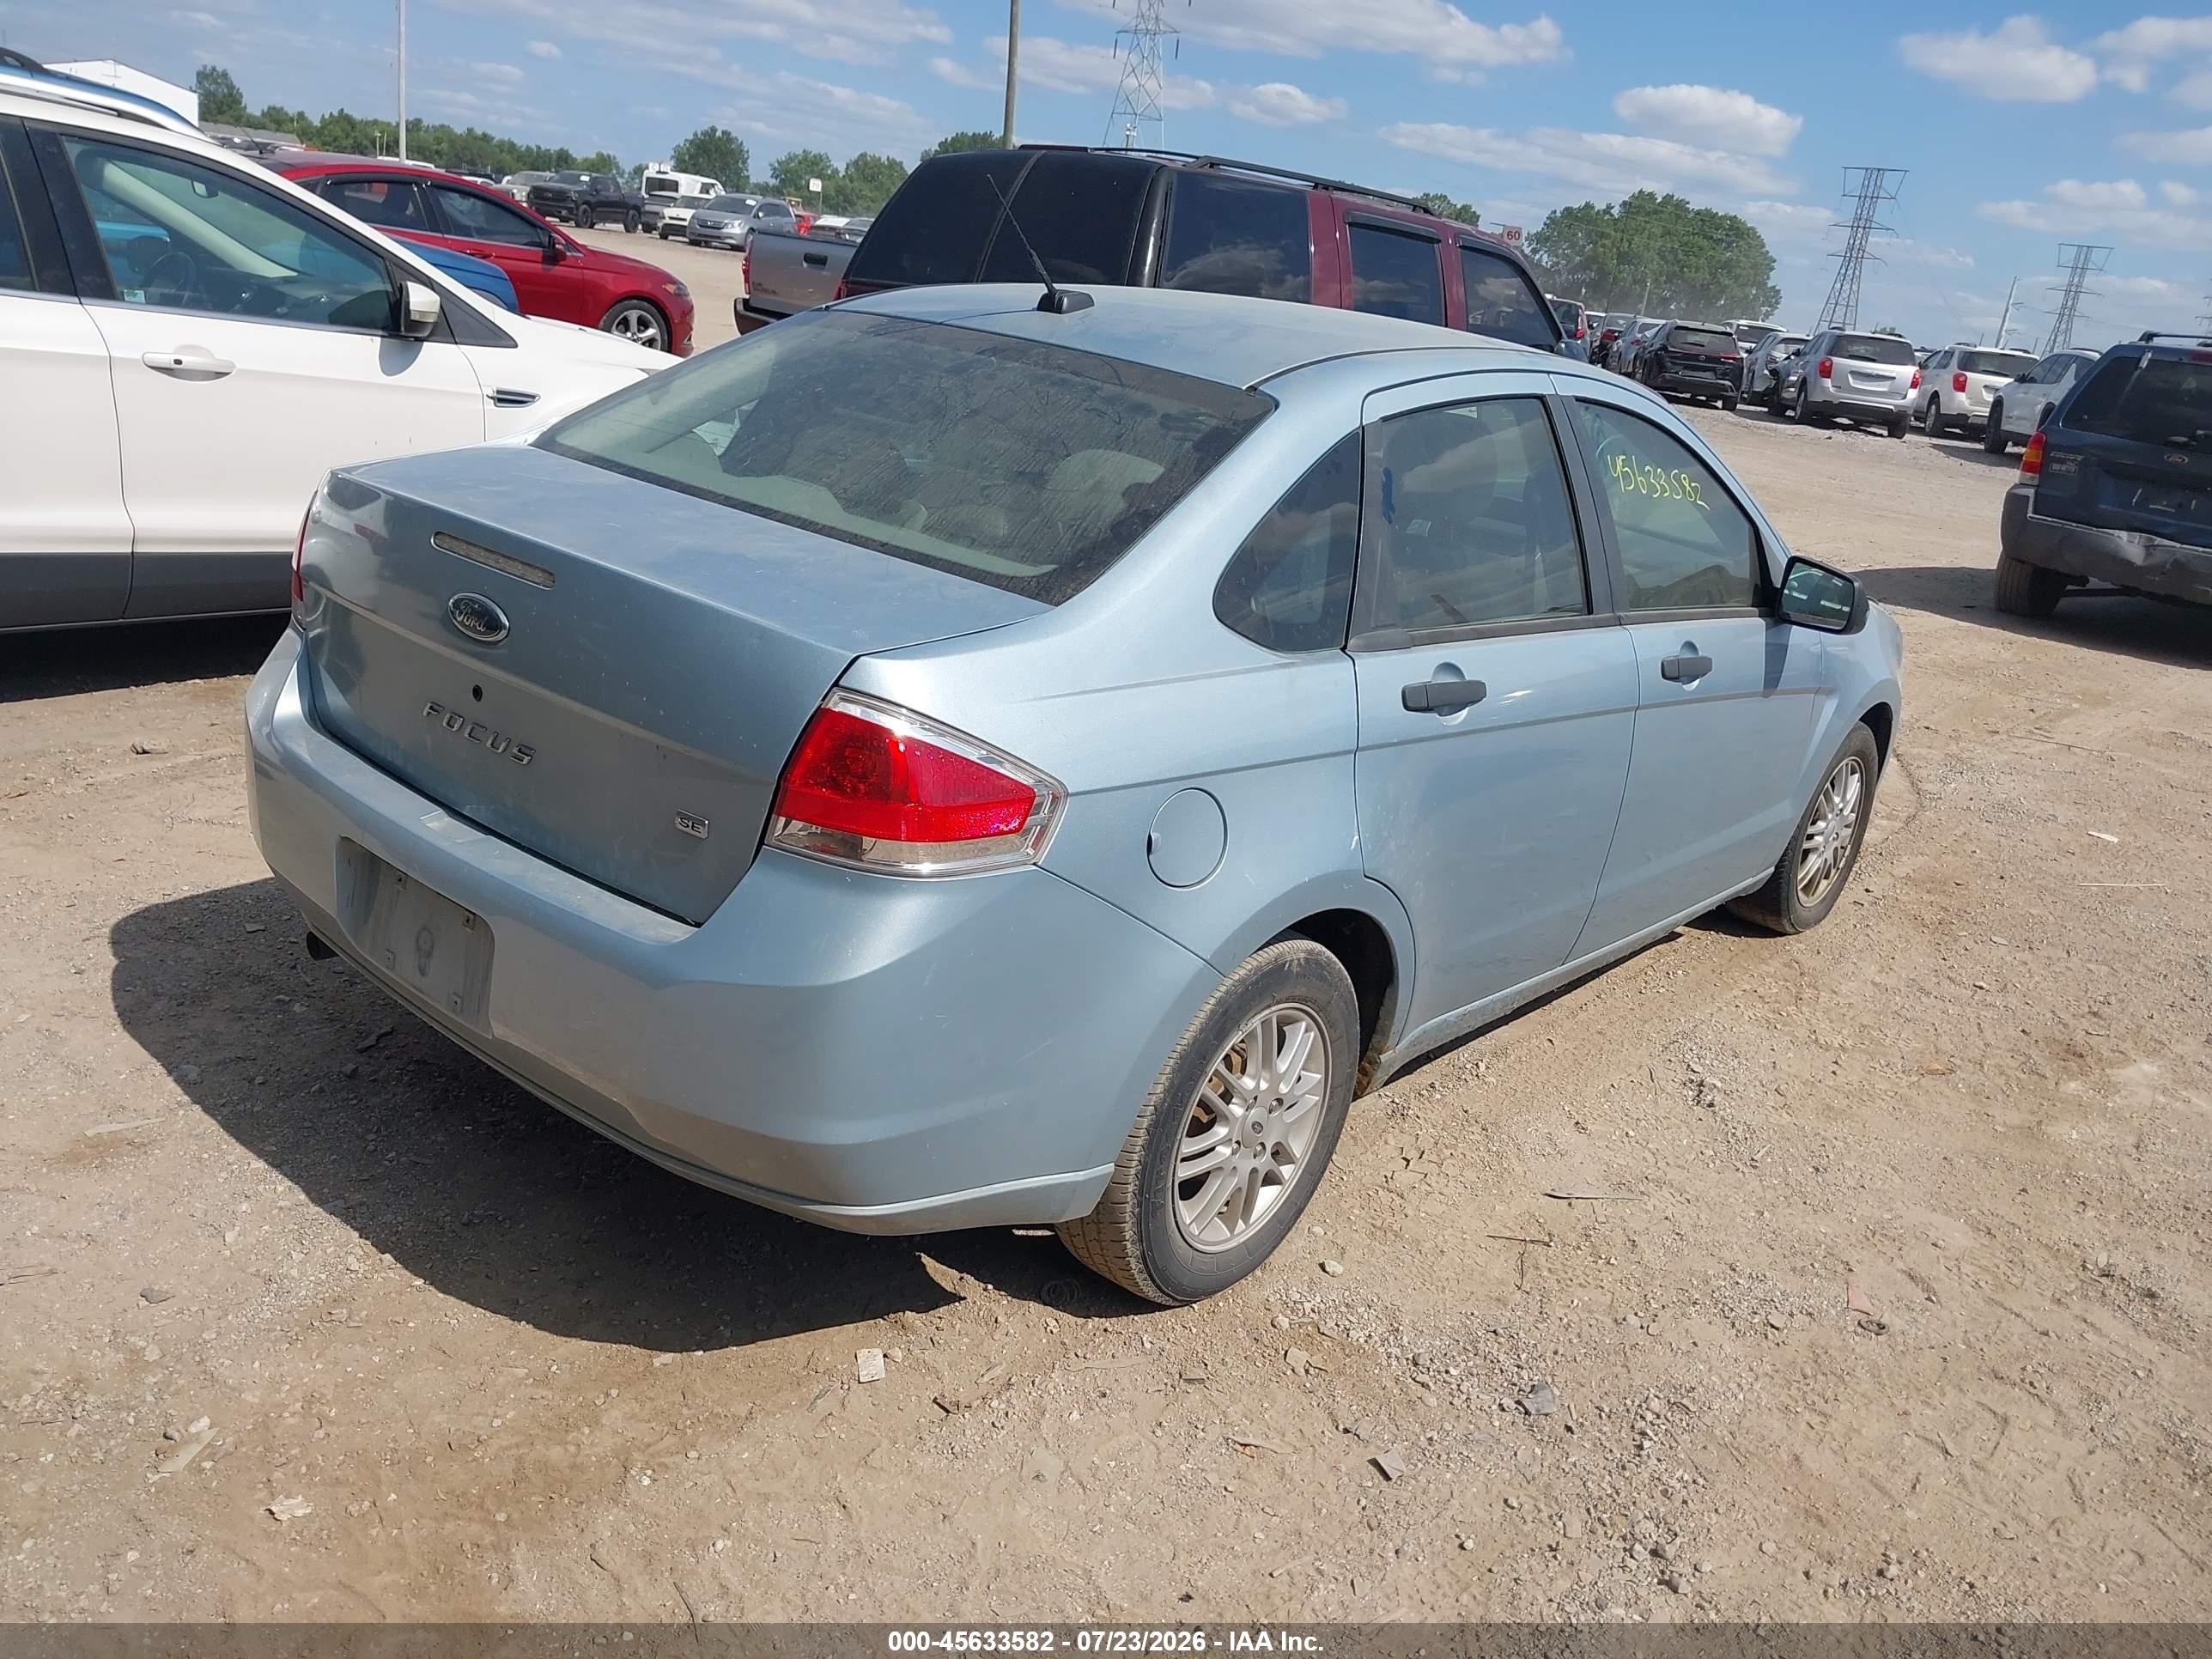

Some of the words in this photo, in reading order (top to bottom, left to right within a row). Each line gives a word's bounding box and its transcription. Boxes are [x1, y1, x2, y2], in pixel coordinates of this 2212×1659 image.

[1507, 231, 1520, 240] 60
[1607, 454, 1711, 510] 45633582
[456, 599, 488, 632] Ford
[422, 702, 537, 764] FOCUS
[678, 817, 702, 834] SE
